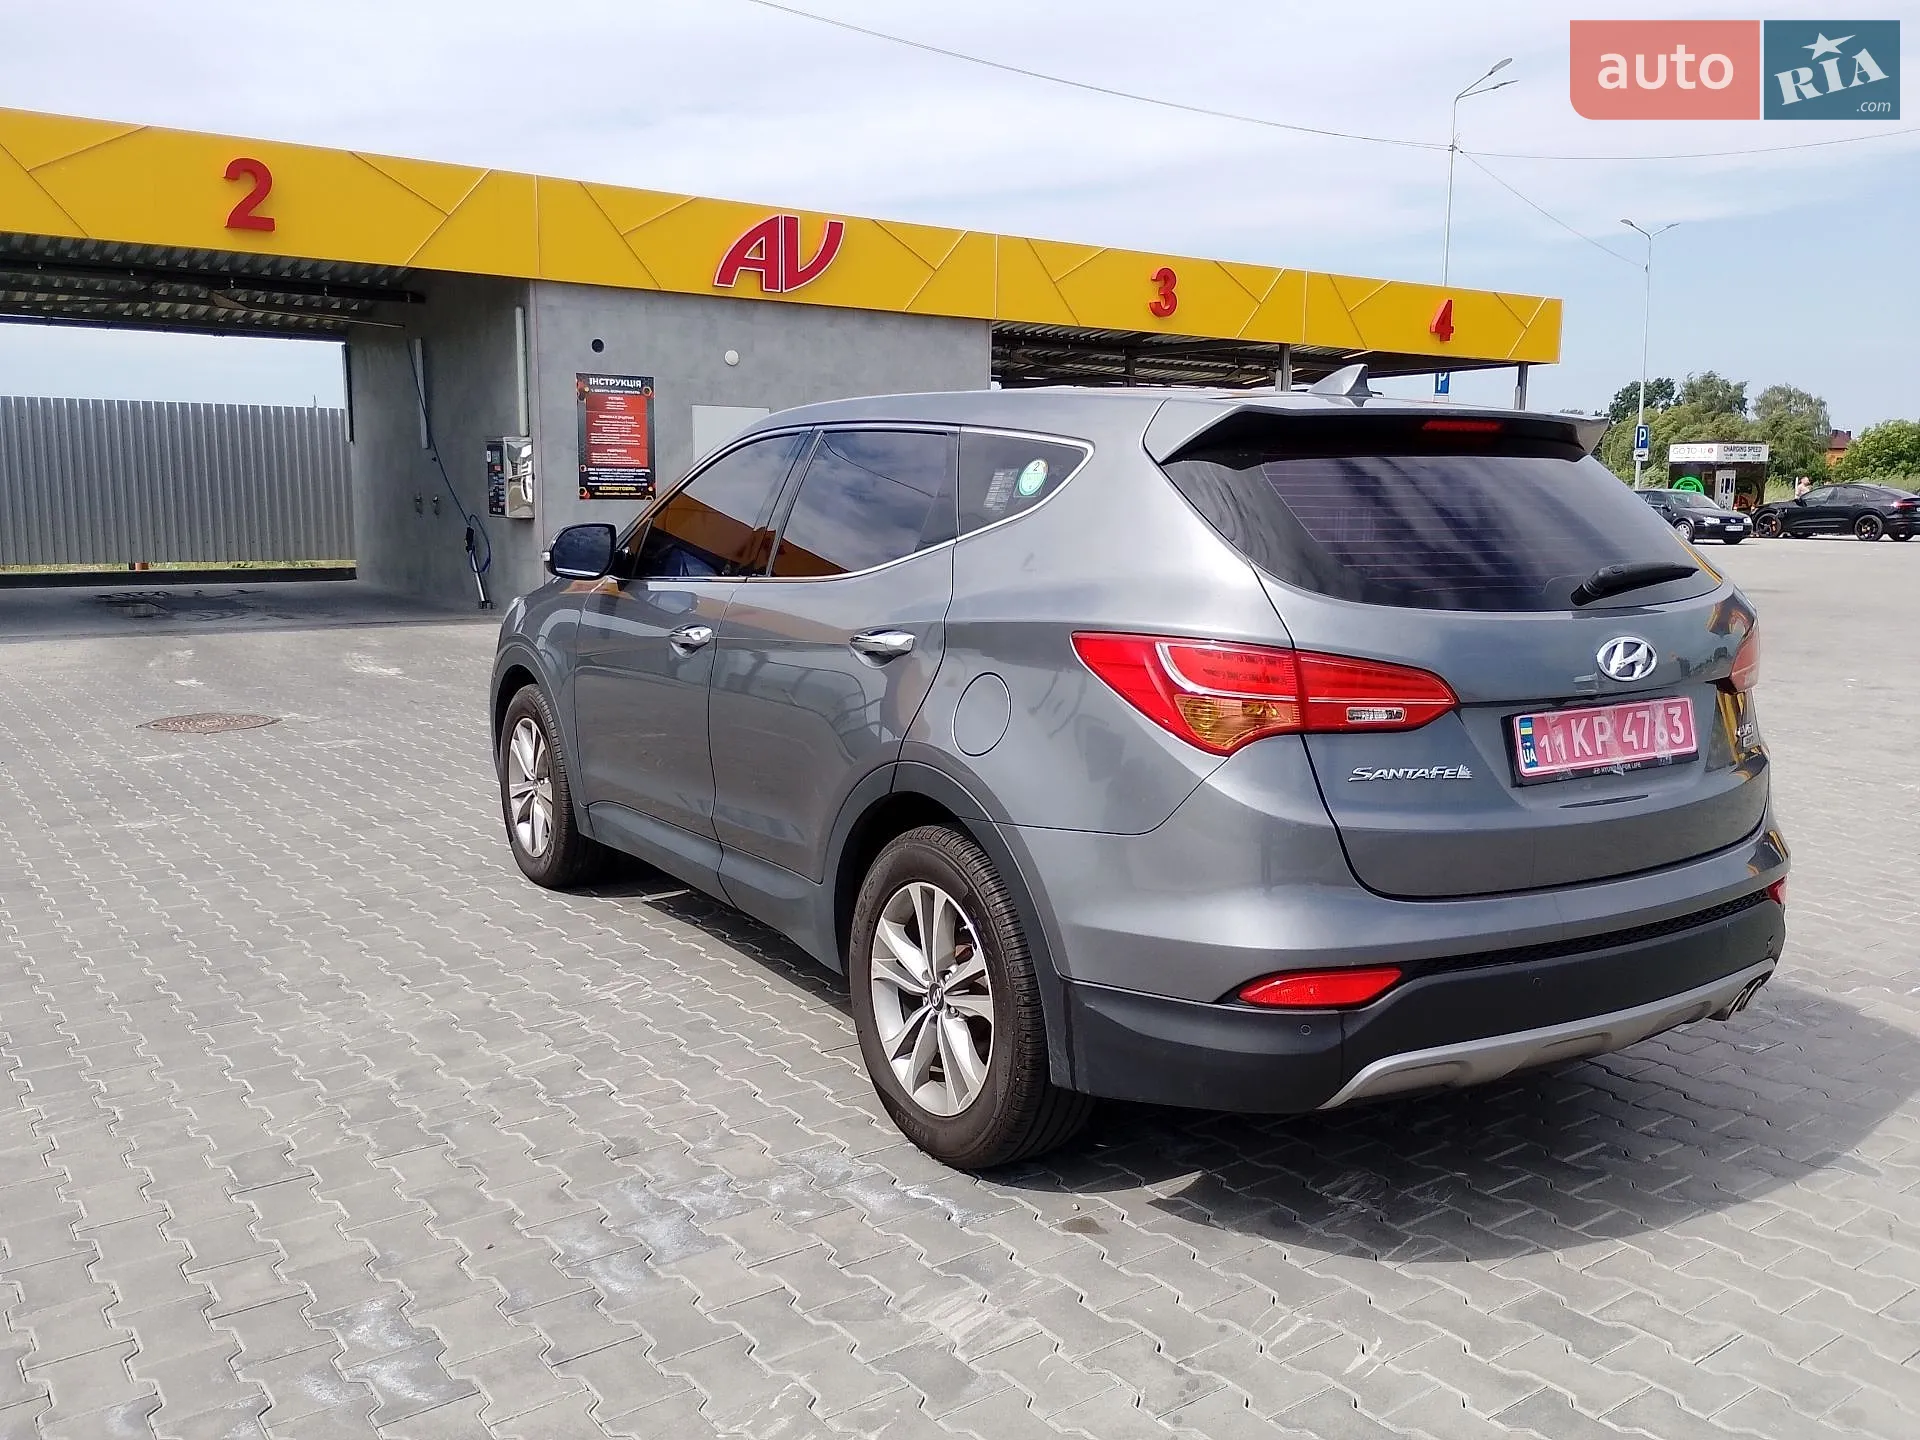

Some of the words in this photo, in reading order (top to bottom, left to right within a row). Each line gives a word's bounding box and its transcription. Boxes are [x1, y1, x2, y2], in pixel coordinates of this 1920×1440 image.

[222, 157, 276, 232] 2
[713, 214, 845, 293] AV
[1148, 266, 1178, 318] 3
[1429, 298, 1455, 342] 4
[589, 377, 642, 388] ІНСТРУКЦІЯ
[1638, 428, 1647, 447] P
[1523, 748, 1538, 764] UA
